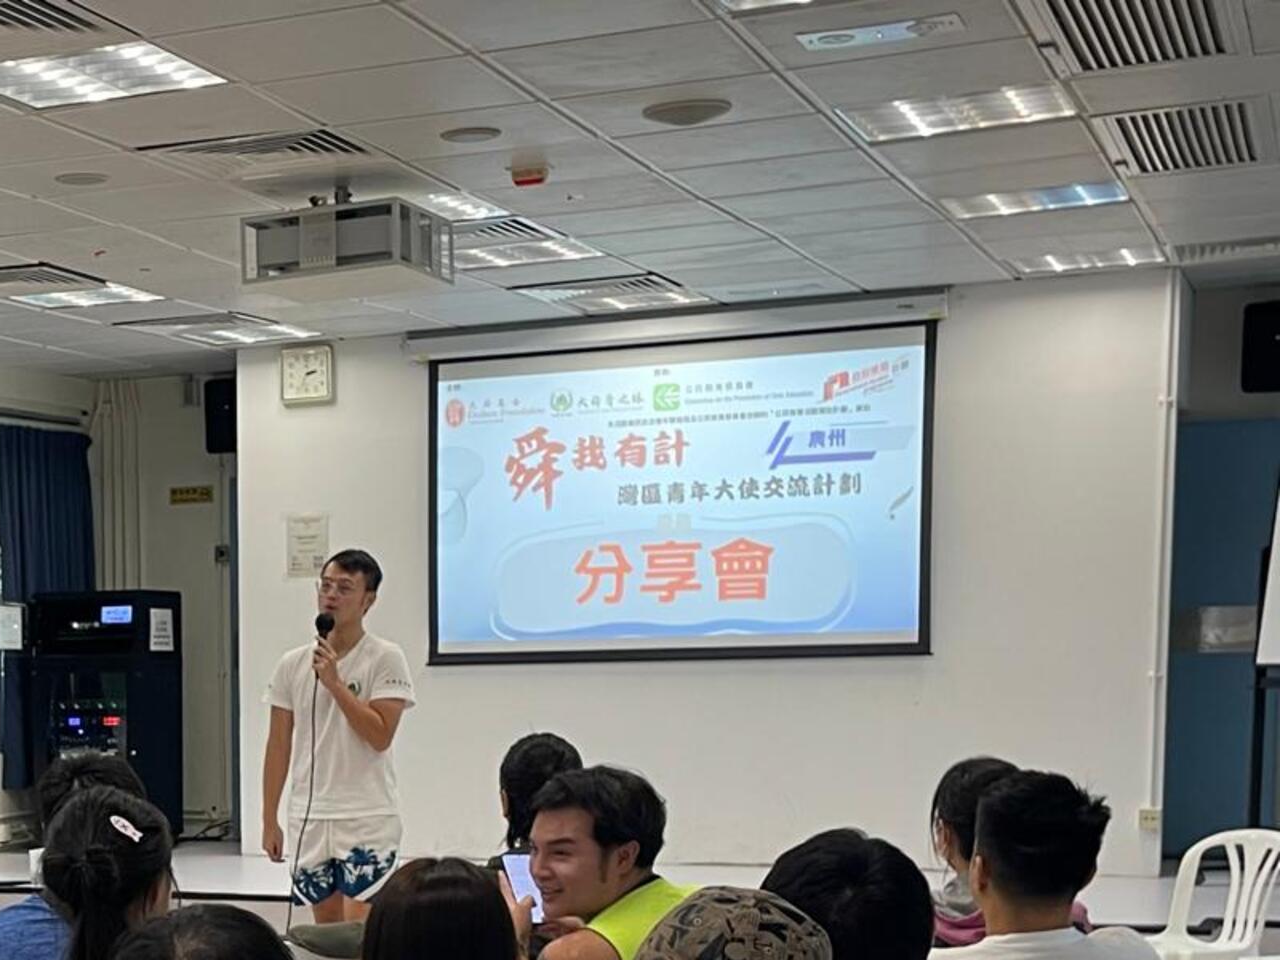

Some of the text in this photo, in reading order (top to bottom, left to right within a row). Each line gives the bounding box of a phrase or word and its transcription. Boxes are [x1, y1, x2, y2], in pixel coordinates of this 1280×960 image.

[617, 472, 862, 506] 灣區青年大使交流計劃
[574, 537, 775, 604] 分享會
